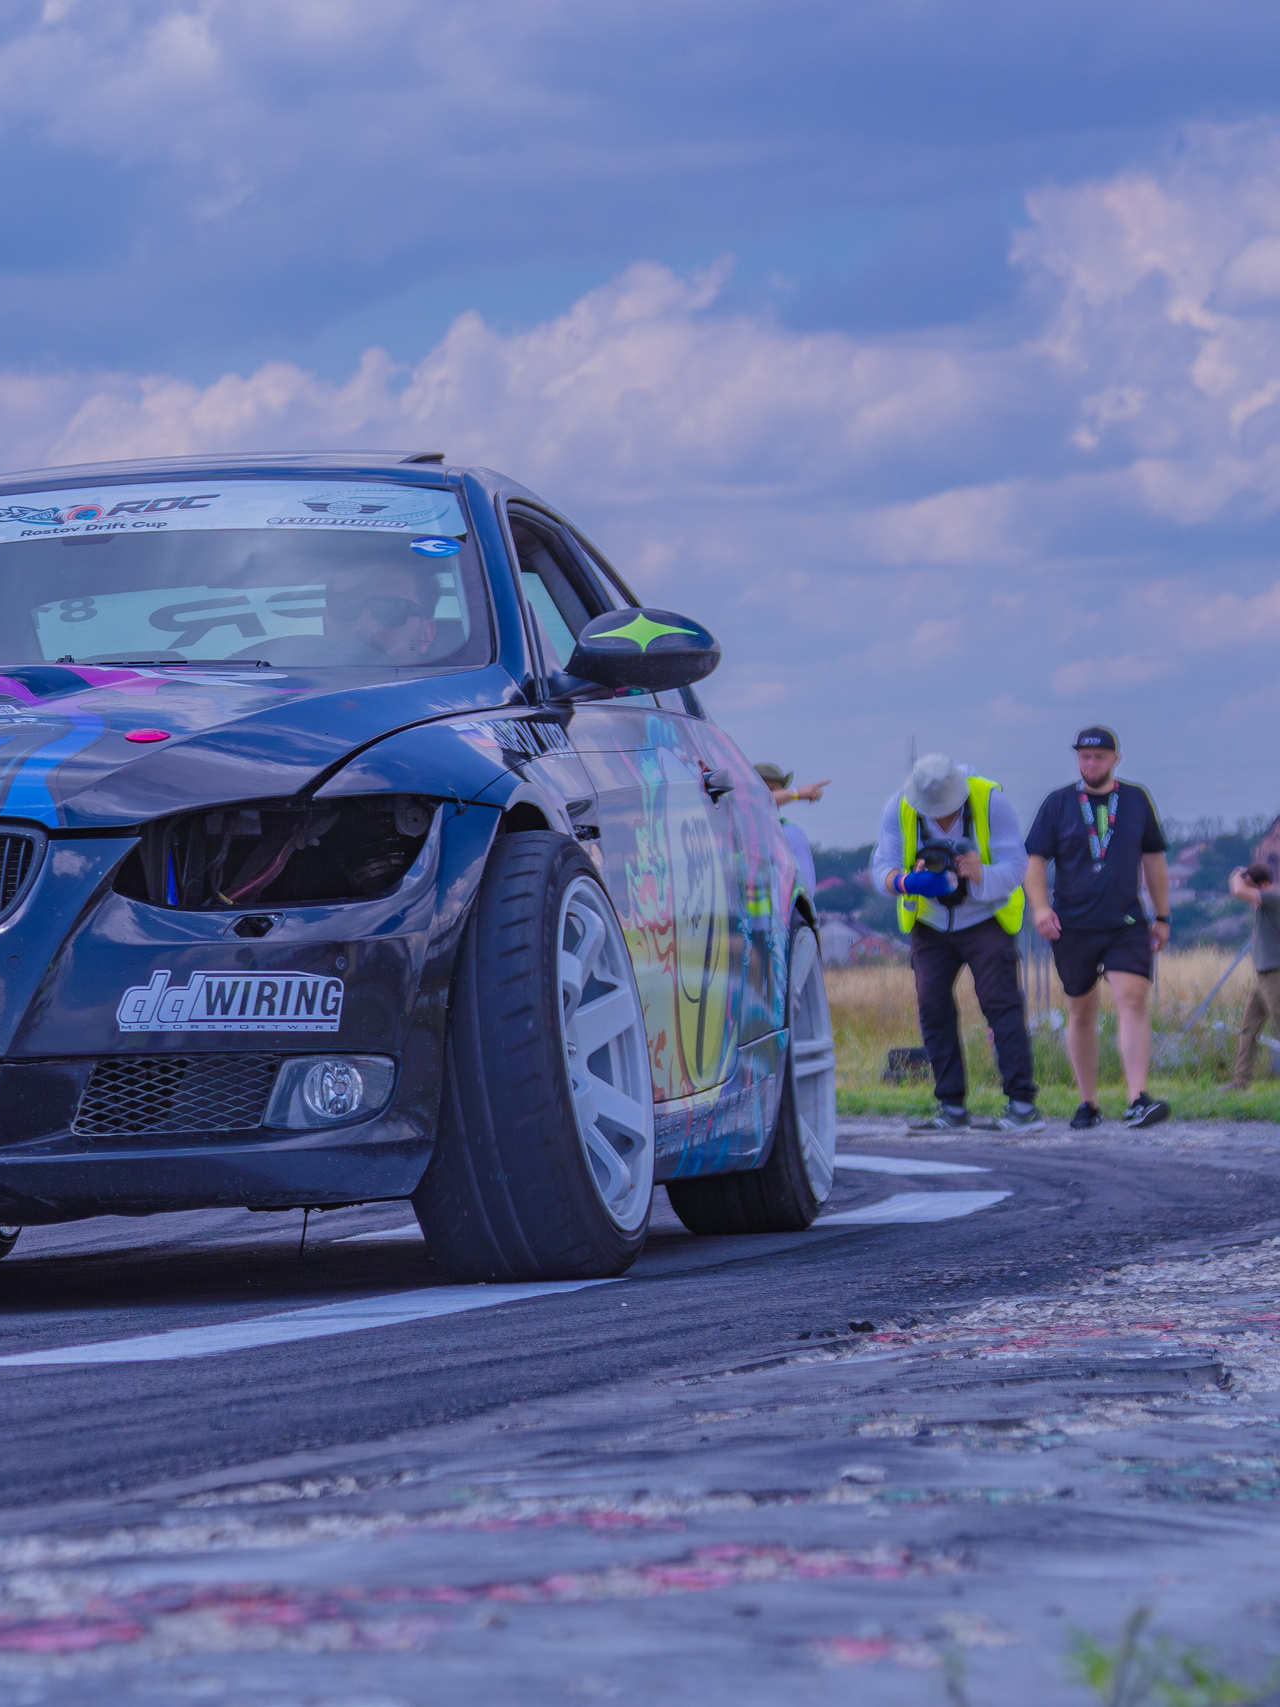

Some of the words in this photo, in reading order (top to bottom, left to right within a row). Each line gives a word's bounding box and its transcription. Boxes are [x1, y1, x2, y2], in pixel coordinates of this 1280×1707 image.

[106, 493, 221, 516] RDC
[20, 527, 80, 538] Rostov
[85, 521, 126, 532] Drift
[132, 520, 168, 530] Cup
[121, 1023, 338, 1031] MOTORSPORTWIRE
